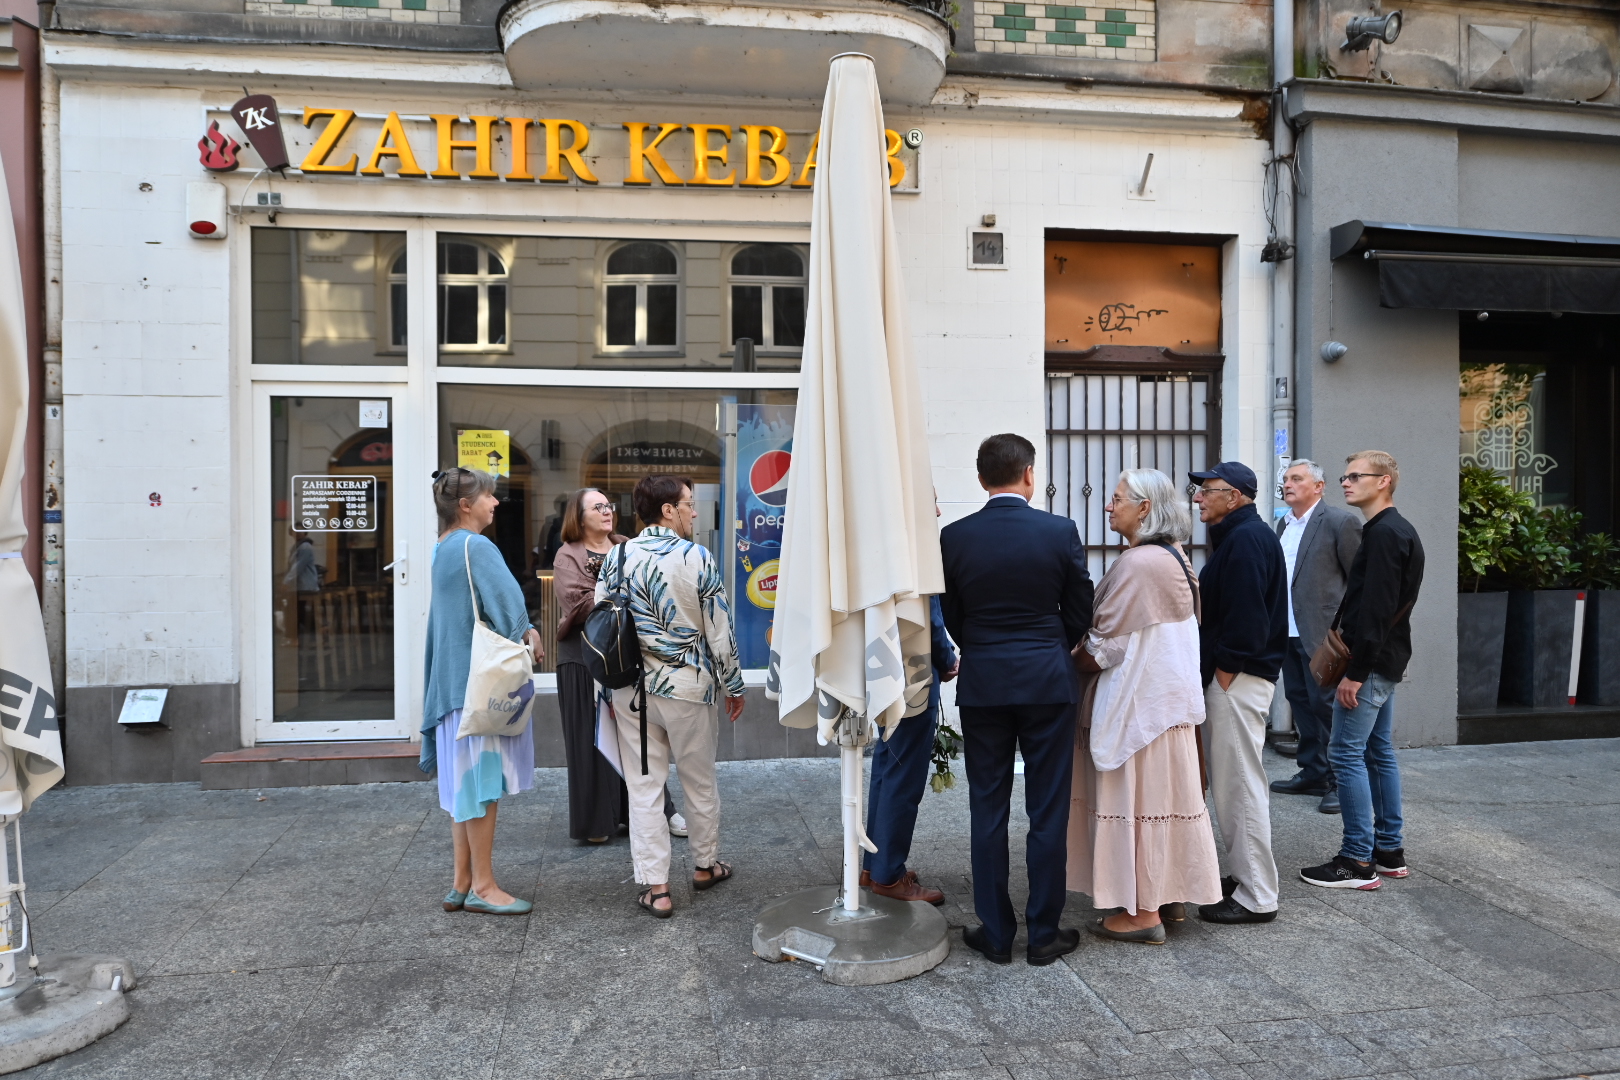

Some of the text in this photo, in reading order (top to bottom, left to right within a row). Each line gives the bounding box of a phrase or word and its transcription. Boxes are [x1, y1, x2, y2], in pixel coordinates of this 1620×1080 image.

[240, 106, 275, 129] ZK
[300, 106, 598, 185] ZAHIR
[976, 240, 997, 257] 14
[302, 481, 368, 489] ZAHIR KEBAB
